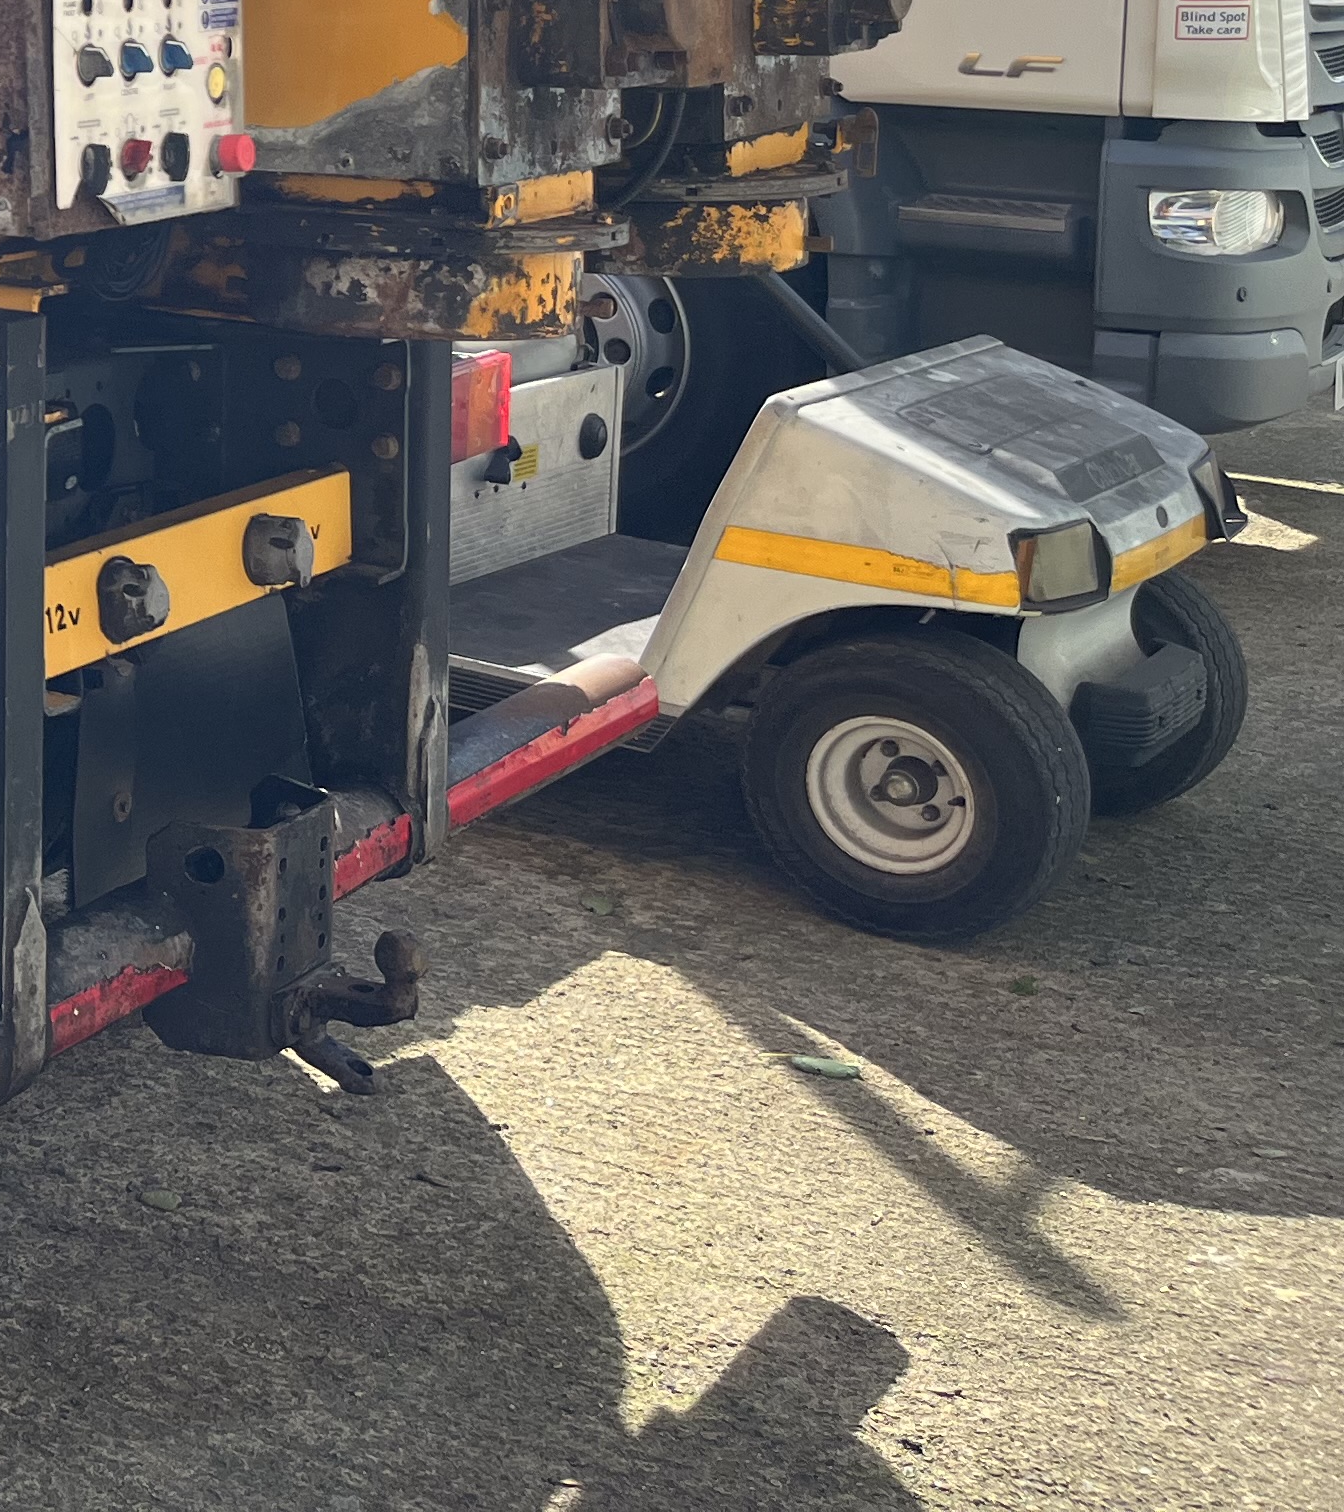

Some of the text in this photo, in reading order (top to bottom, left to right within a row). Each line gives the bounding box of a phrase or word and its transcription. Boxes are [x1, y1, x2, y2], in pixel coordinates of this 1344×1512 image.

[1180, 11, 1246, 24] Blind Spot
[1184, 25, 1242, 35] Take care
[45, 603, 81, 634] 12v
